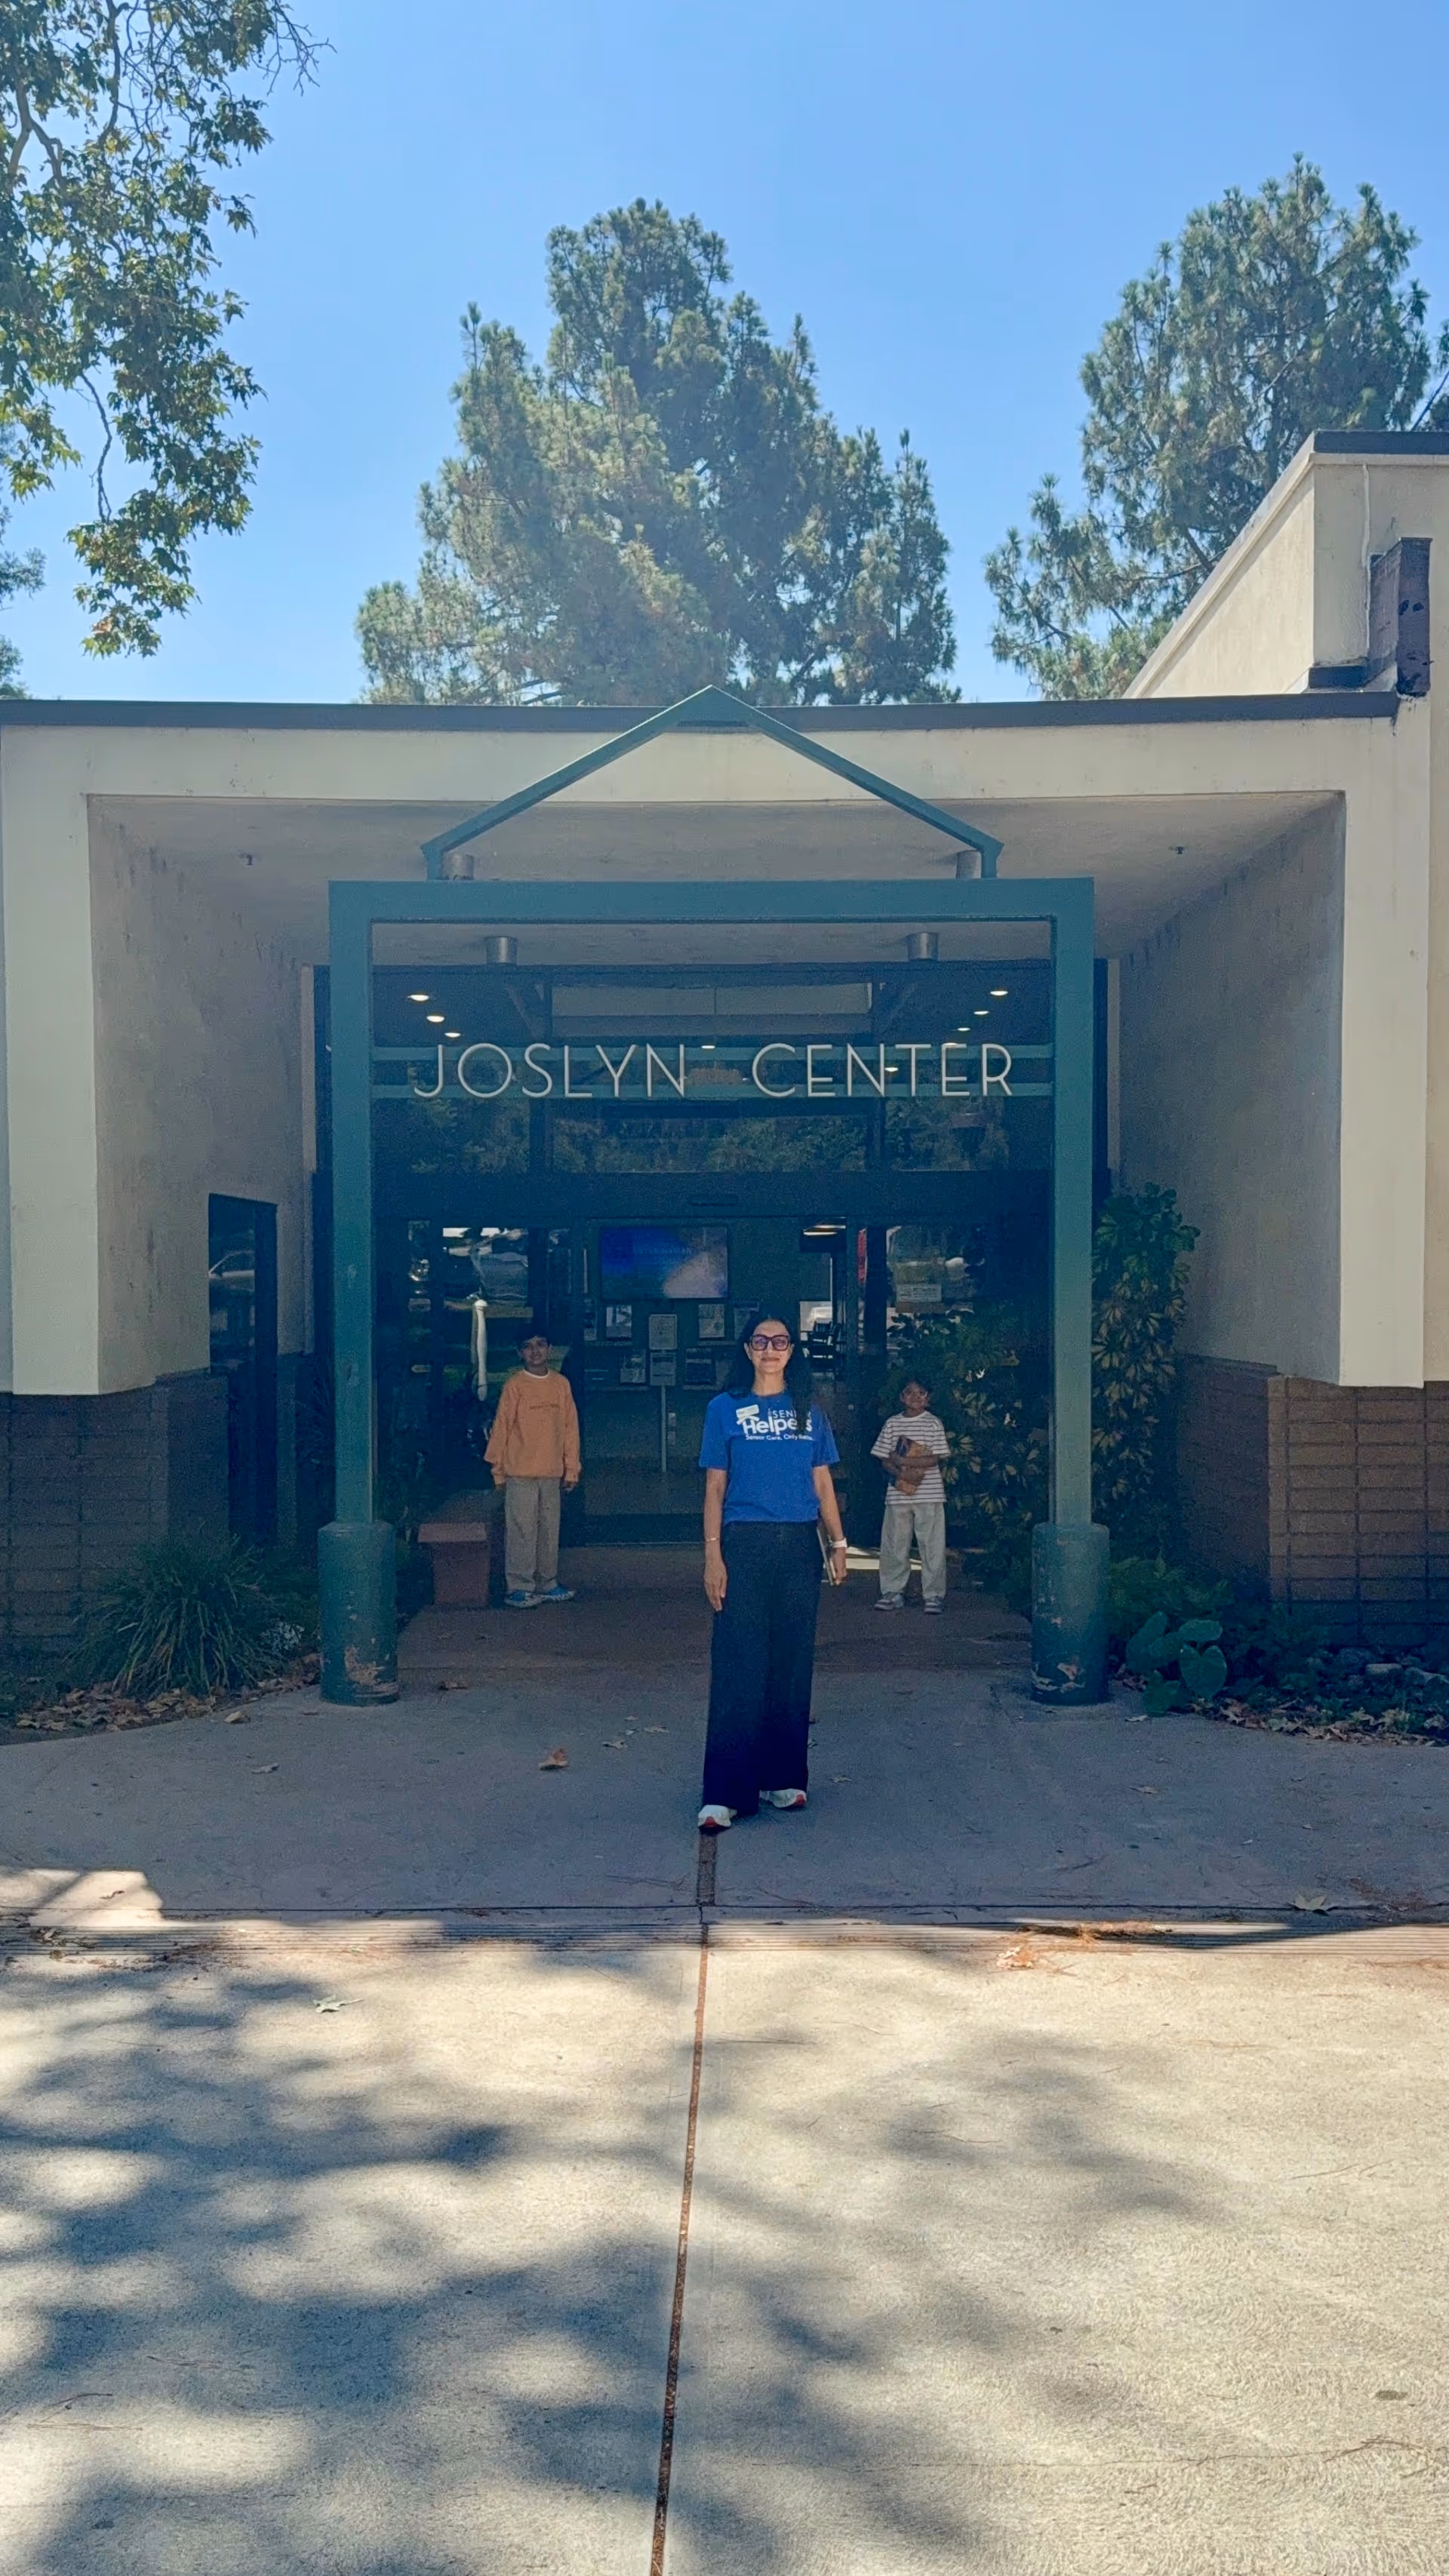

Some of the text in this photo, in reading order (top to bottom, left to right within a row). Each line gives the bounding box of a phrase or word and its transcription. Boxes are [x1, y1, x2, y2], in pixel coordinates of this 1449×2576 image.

[414, 1042, 1013, 1097] JOSLYN CENTER
[772, 1409, 811, 1419] SENI
[742, 1415, 813, 1435] Helpes
